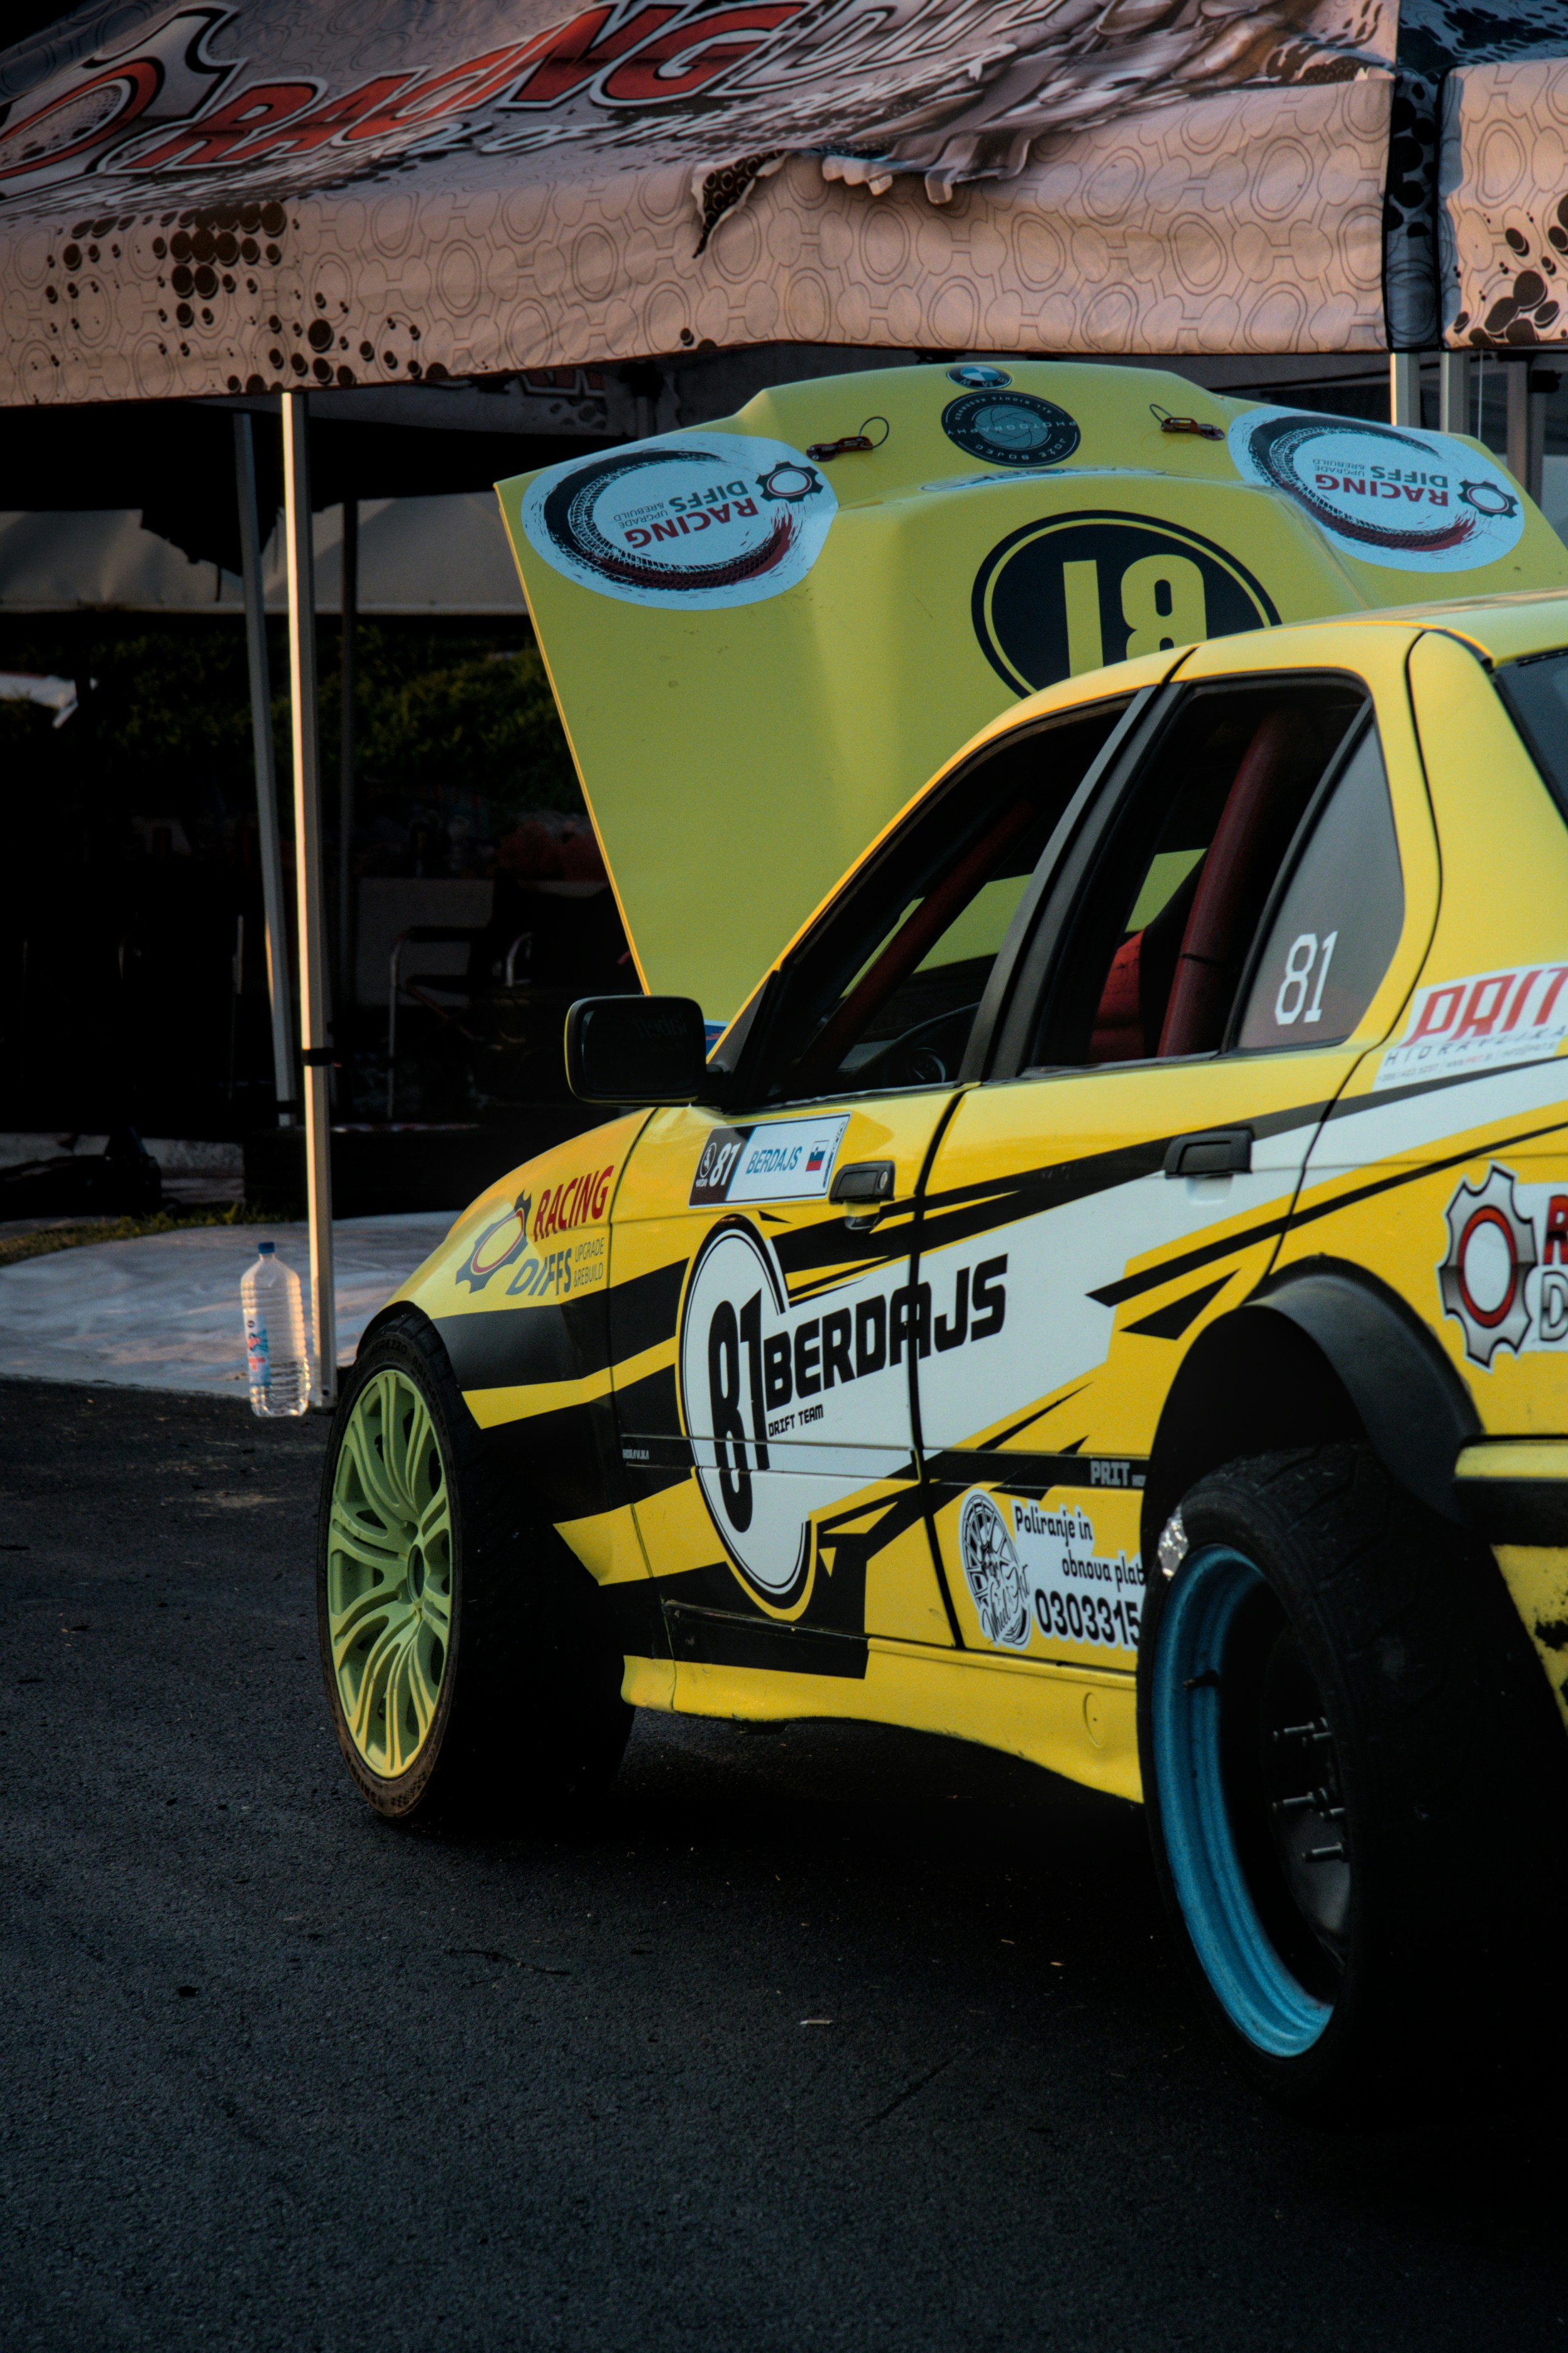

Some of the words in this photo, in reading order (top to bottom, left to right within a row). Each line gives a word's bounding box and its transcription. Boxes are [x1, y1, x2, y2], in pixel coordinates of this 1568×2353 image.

[106, 1, 808, 175] RACING
[945, 420, 1076, 436] PHOTOGRAPHY
[1311, 458, 1366, 470] &REBUILD
[1313, 465, 1366, 478] UPGRADE
[1369, 465, 1448, 489] DIFFS
[667, 479, 748, 514] DIFFS
[1314, 473, 1449, 507] RACING
[612, 501, 667, 522] &REBUILD
[616, 508, 669, 530] UPGRADE
[623, 497, 760, 549] RACING
[1275, 930, 1339, 1026] 81
[708, 1142, 742, 1188] 81
[745, 1145, 804, 1175] BERDAJS
[533, 1165, 615, 1242] RACING
[574, 1237, 605, 1263] UPGRADE
[505, 1247, 573, 1297] DIFFS
[573, 1262, 604, 1288] &REBUILD
[762, 1252, 1009, 1413] BERDAJS
[707, 1286, 771, 1534] 81
[767, 1414, 797, 1438] DRIFT
[796, 1402, 825, 1426] TEAM
[1090, 1460, 1131, 1487] PRIT
[1014, 1505, 1075, 1548] Poliranje
[1077, 1511, 1094, 1541] in
